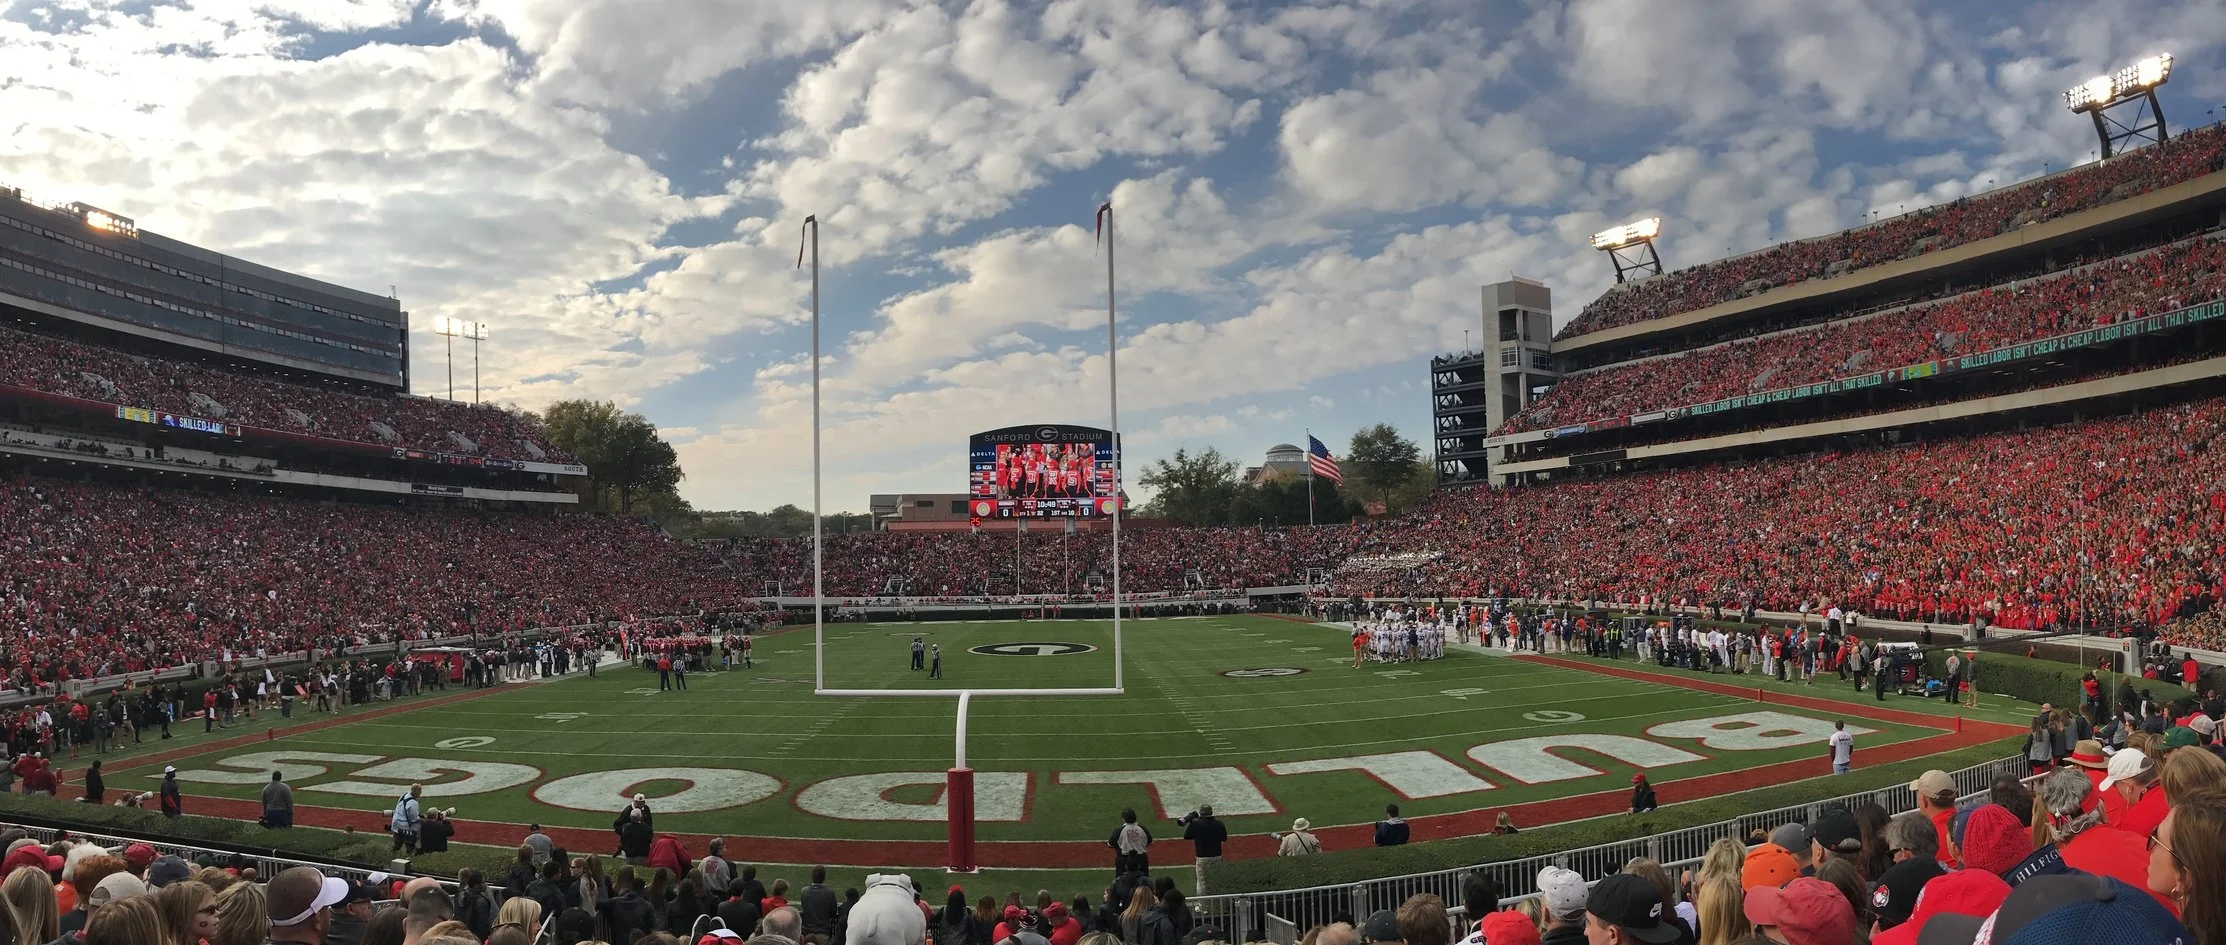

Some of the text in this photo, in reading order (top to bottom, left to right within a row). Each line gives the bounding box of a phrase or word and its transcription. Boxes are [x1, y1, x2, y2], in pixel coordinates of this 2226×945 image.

[1960, 302, 2225, 369] SKILLED LABOR ISN'T CHEAP & CHEAP LABOR ISN'T ALL THAT SKILLED
[1691, 374, 1882, 416] SKILLED LABOR ISN'T CHEAP & CHEAP LABOR ISN'T ALL THAT SKILLED
[179, 417, 207, 431] SKILLED
[984, 433, 1031, 442] SANFORD
[1061, 432, 1103, 440] STADIUM
[1002, 508, 1009, 517] 0
[1083, 507, 1089, 516] 0
[970, 517, 981, 526] 25
[2016, 848, 2060, 883] HILFIG
